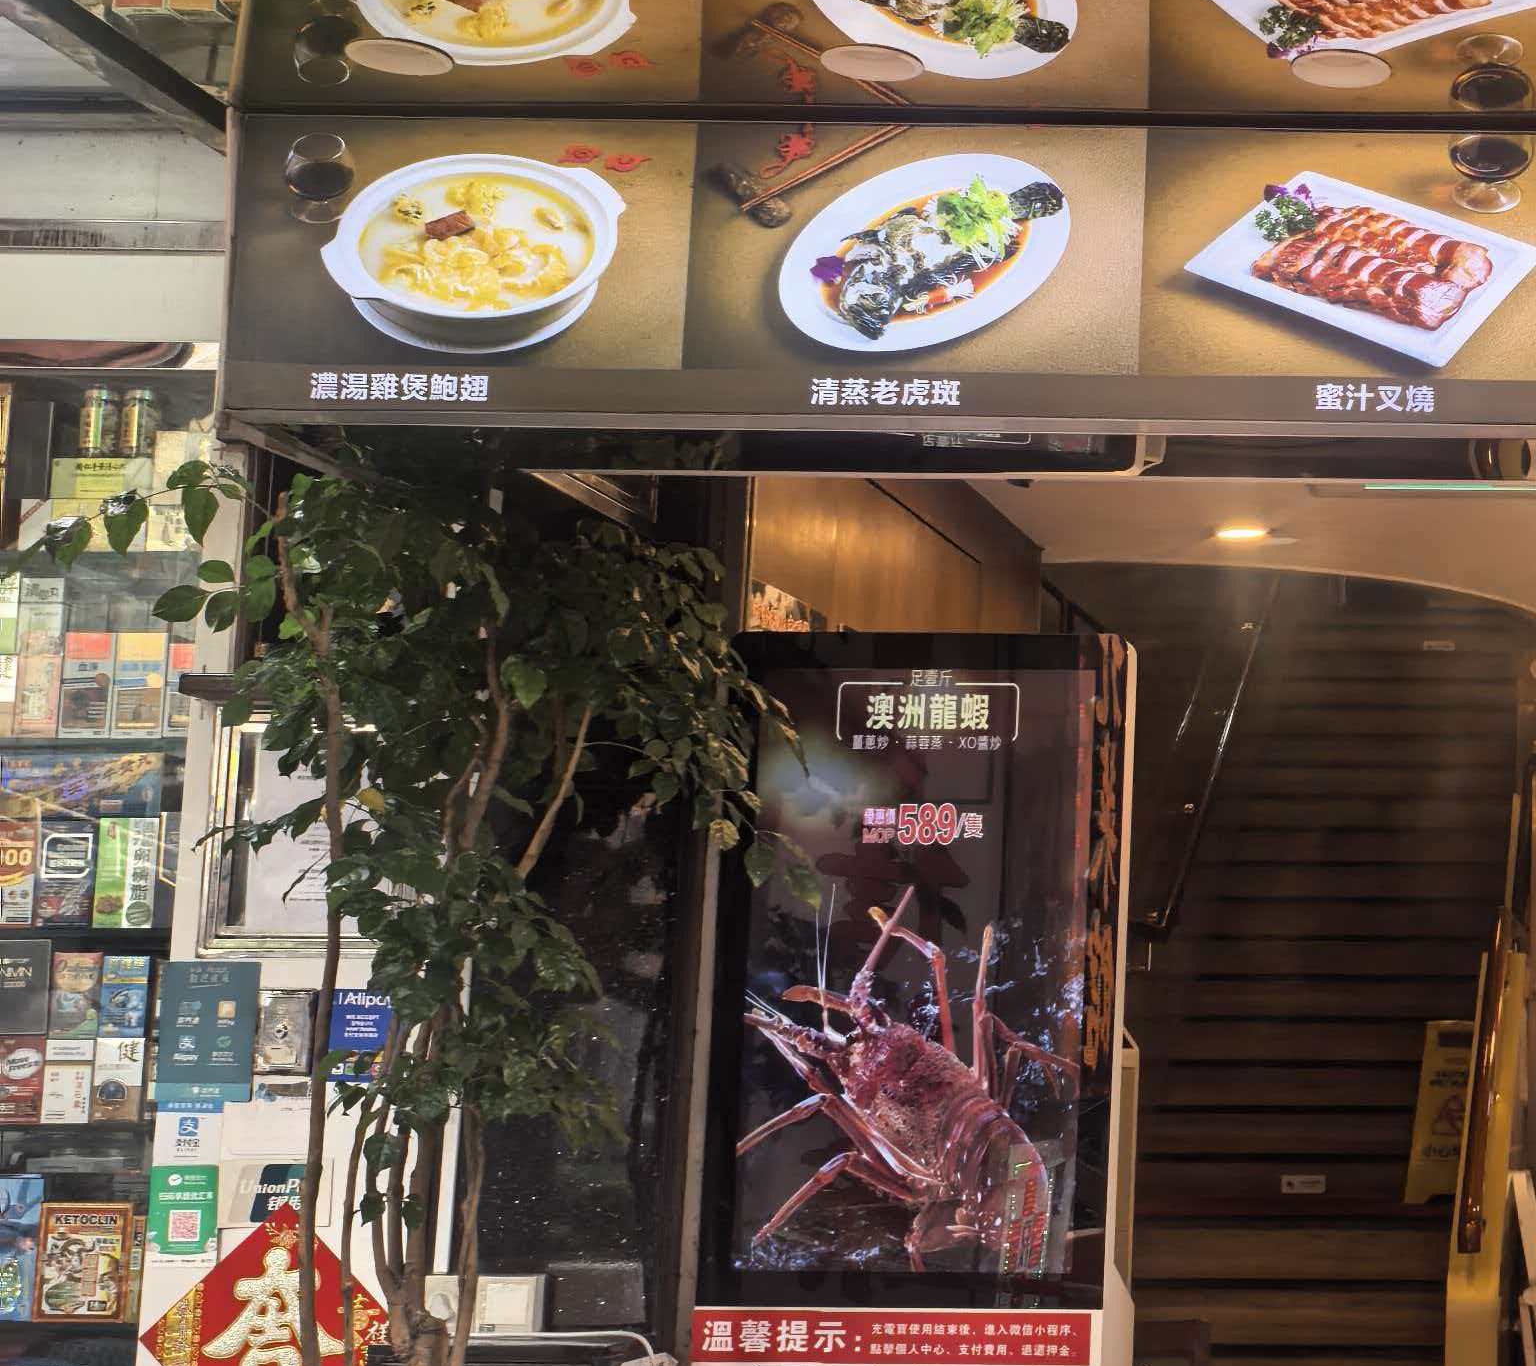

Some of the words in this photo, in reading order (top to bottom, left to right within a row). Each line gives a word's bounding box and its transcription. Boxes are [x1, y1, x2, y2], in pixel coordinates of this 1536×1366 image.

[309, 372, 490, 403] 濃湯雞煲鮑翅
[810, 377, 961, 407] 清蒸老虎斑
[1315, 384, 1435, 413] 蜜汁叉燒
[865, 693, 990, 731] 澳洲龍蝦
